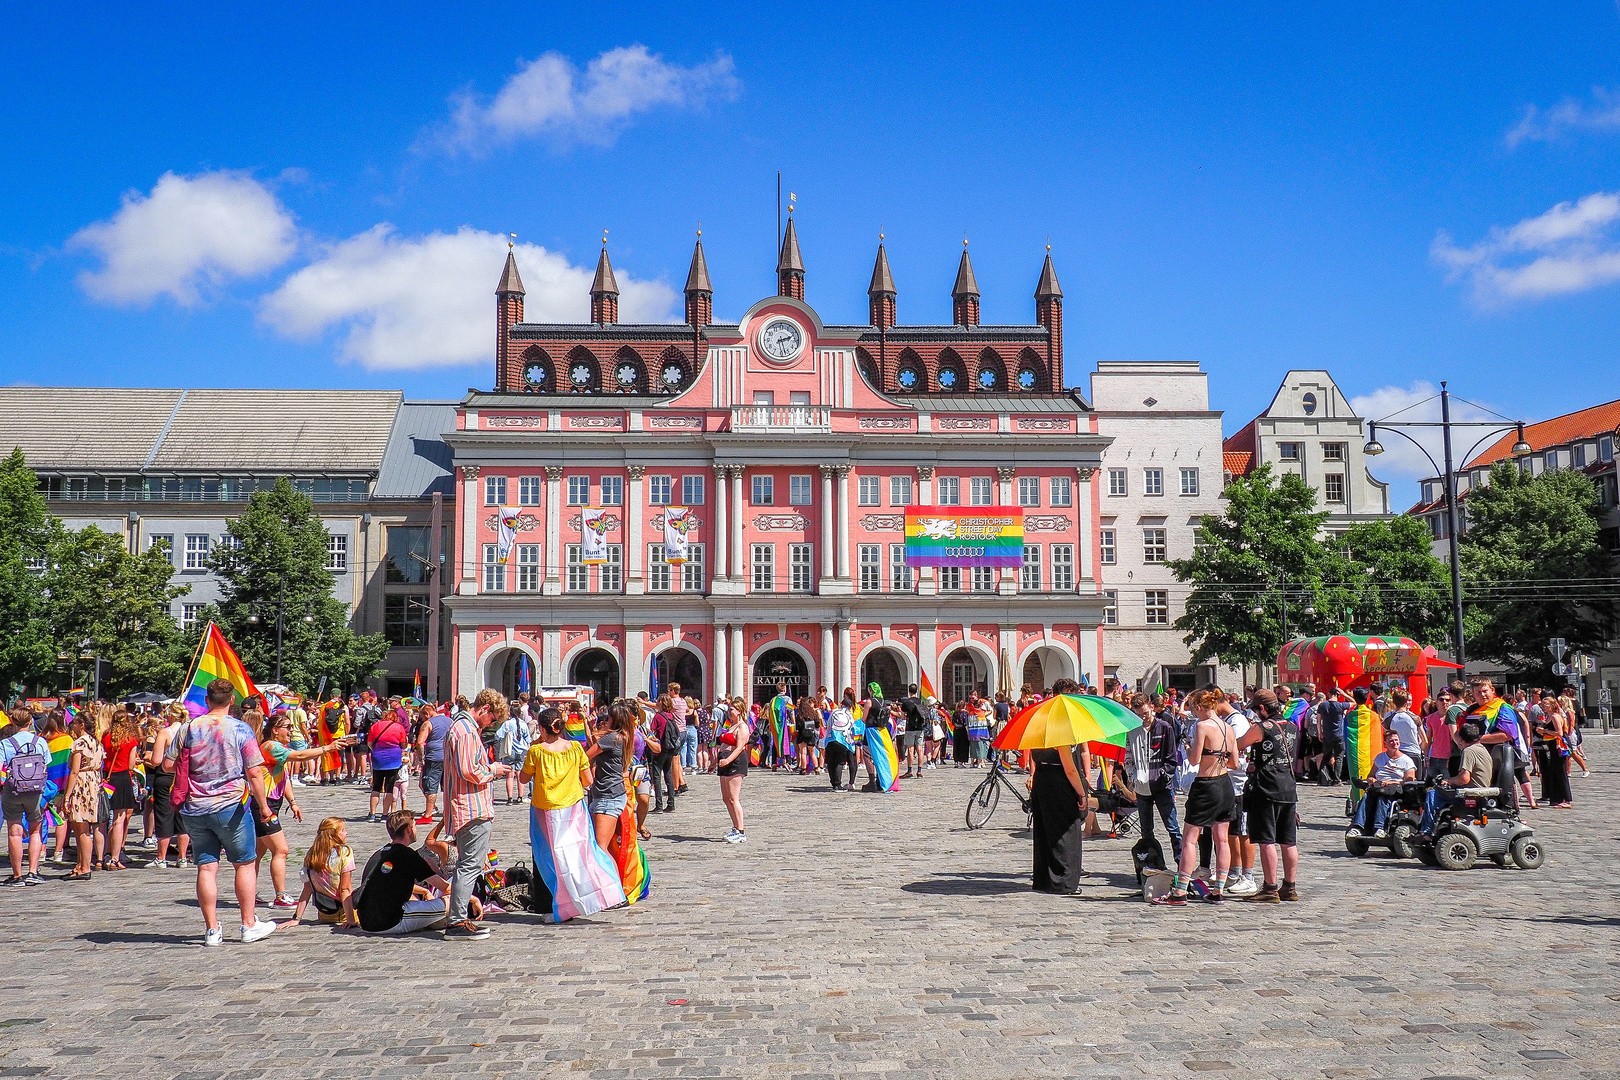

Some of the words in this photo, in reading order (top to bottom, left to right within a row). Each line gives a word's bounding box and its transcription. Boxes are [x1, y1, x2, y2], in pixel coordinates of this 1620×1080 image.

[959, 518, 1014, 526] CHRISTOPHER
[960, 533, 997, 541] ROSTOCK
[757, 676, 807, 684] RATHAUS
